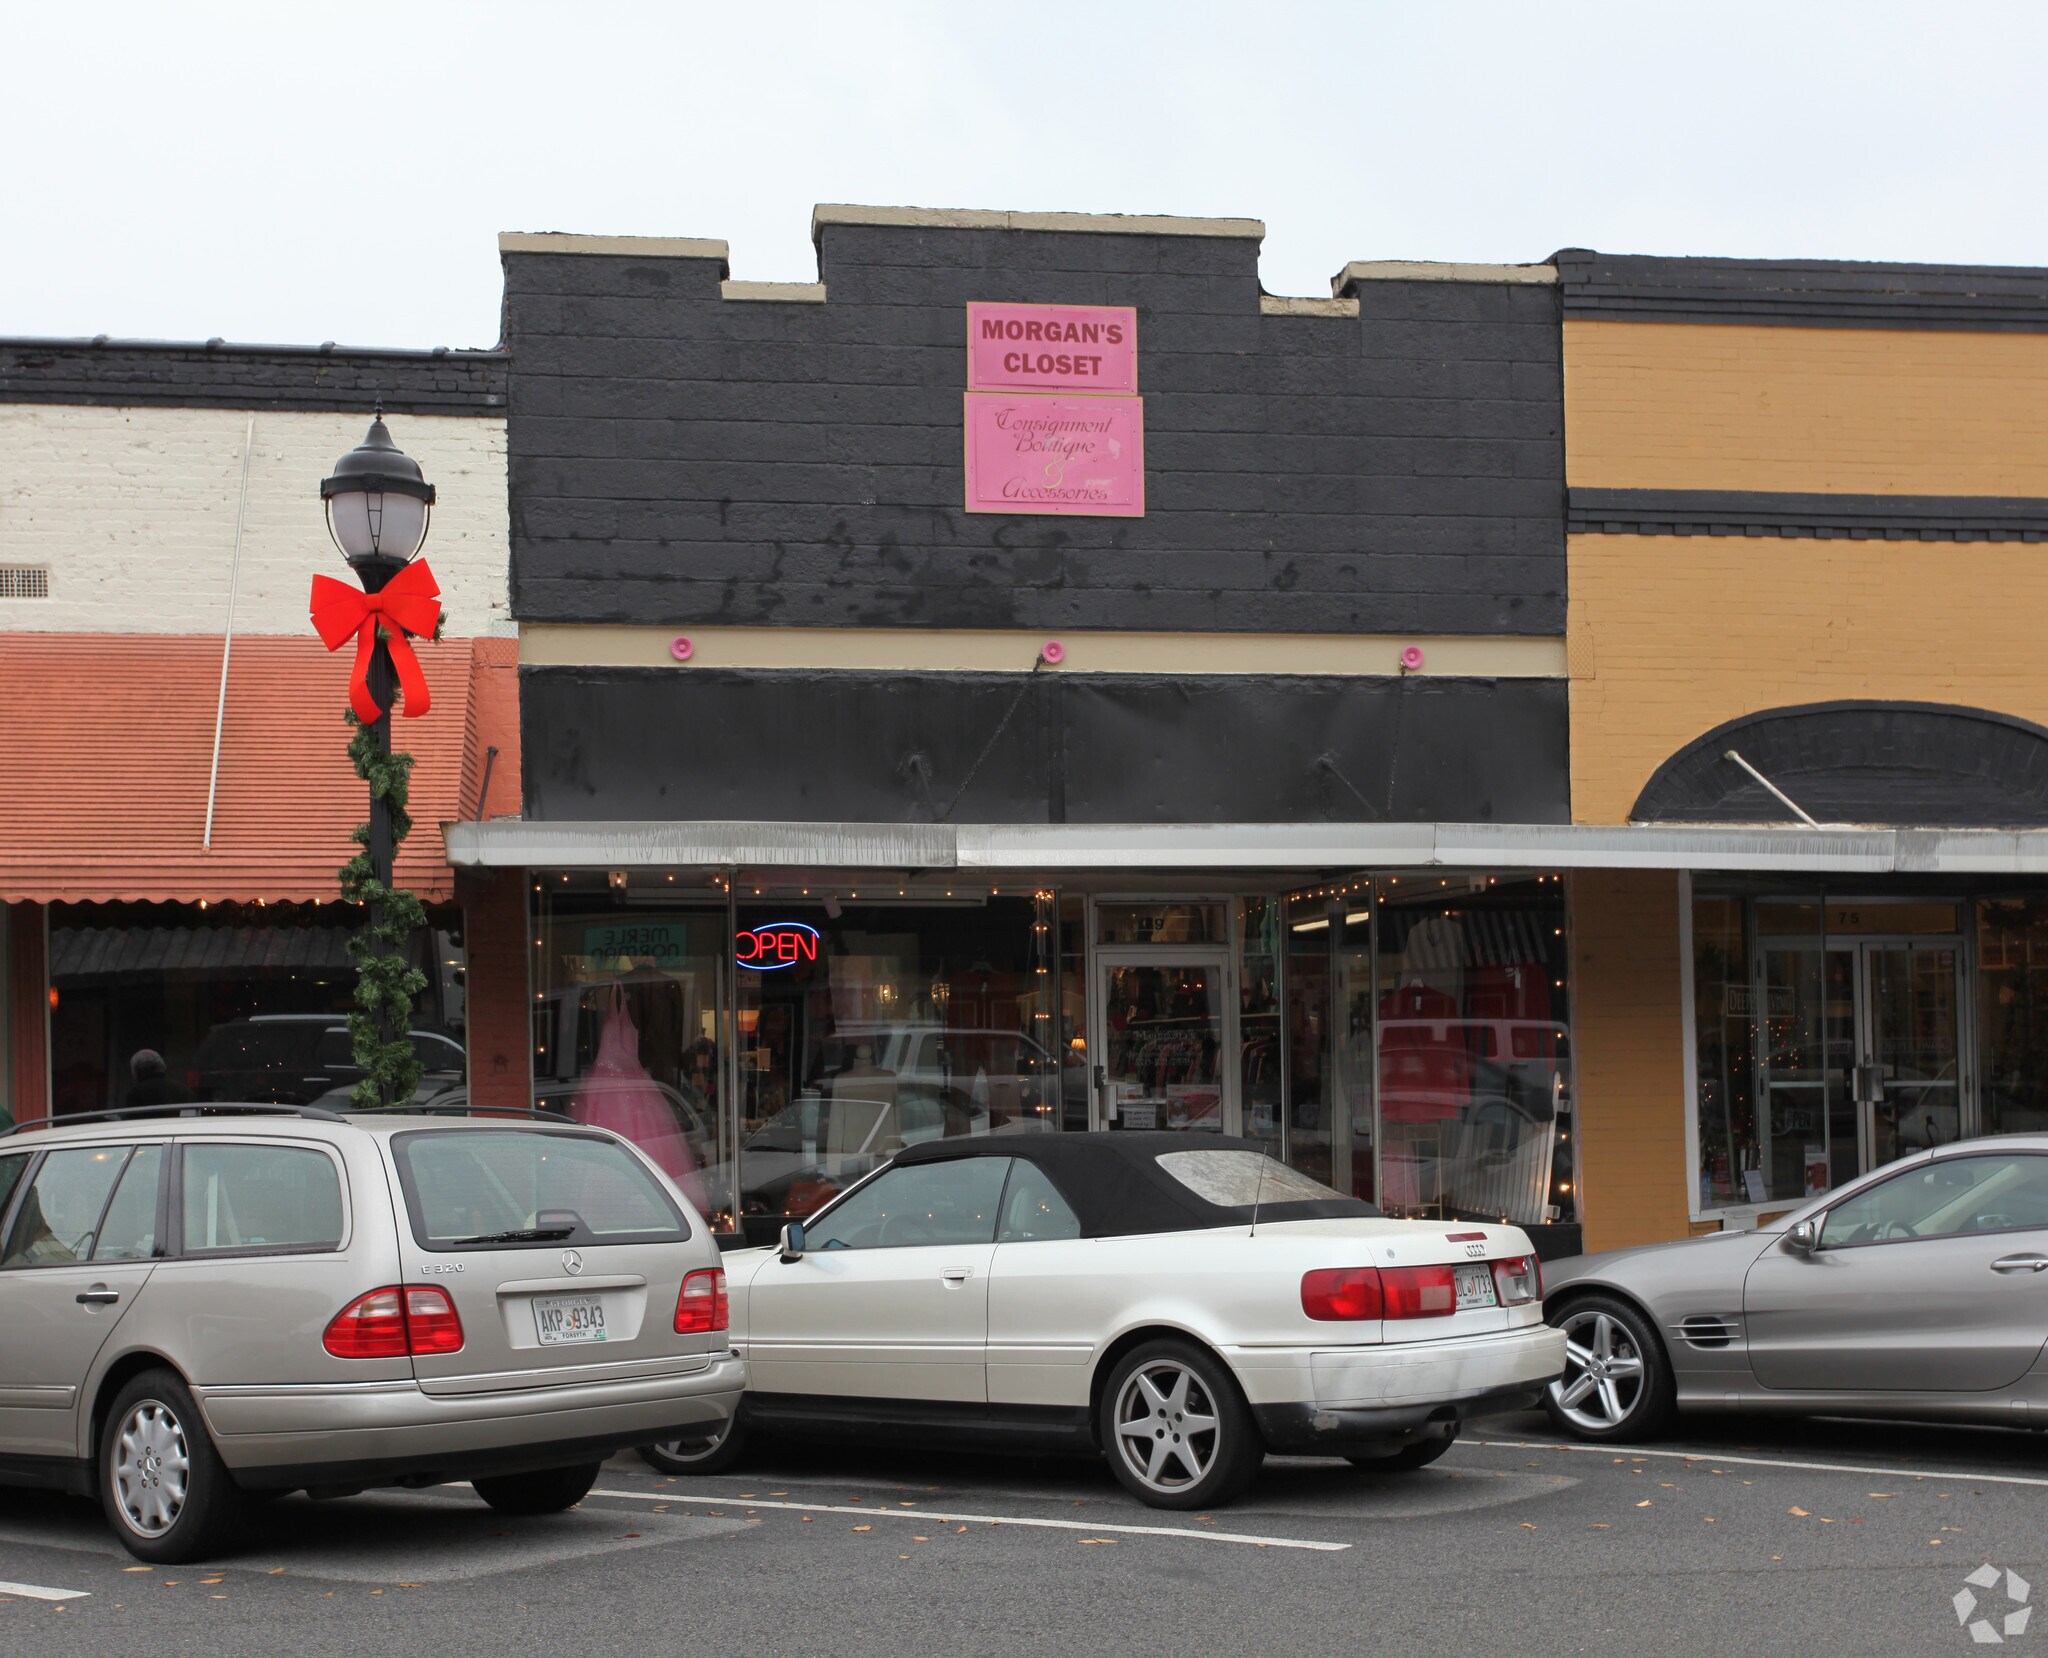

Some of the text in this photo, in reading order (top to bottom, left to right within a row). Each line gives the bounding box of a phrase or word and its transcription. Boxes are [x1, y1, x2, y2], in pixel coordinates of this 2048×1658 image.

[982, 319, 1123, 344] MORGAN'S
[1003, 352, 1102, 376] CLOSET
[995, 408, 1113, 436] Consignment
[1013, 430, 1096, 460] Boutique
[1002, 476, 1108, 500] Accessories
[1839, 912, 1860, 924] 75
[736, 931, 817, 960] OPEN
[421, 1262, 466, 1275] E 320
[1455, 1277, 1467, 1297] DL
[550, 1299, 588, 1307] GEORGIA
[541, 1306, 604, 1332] AKP 9343
